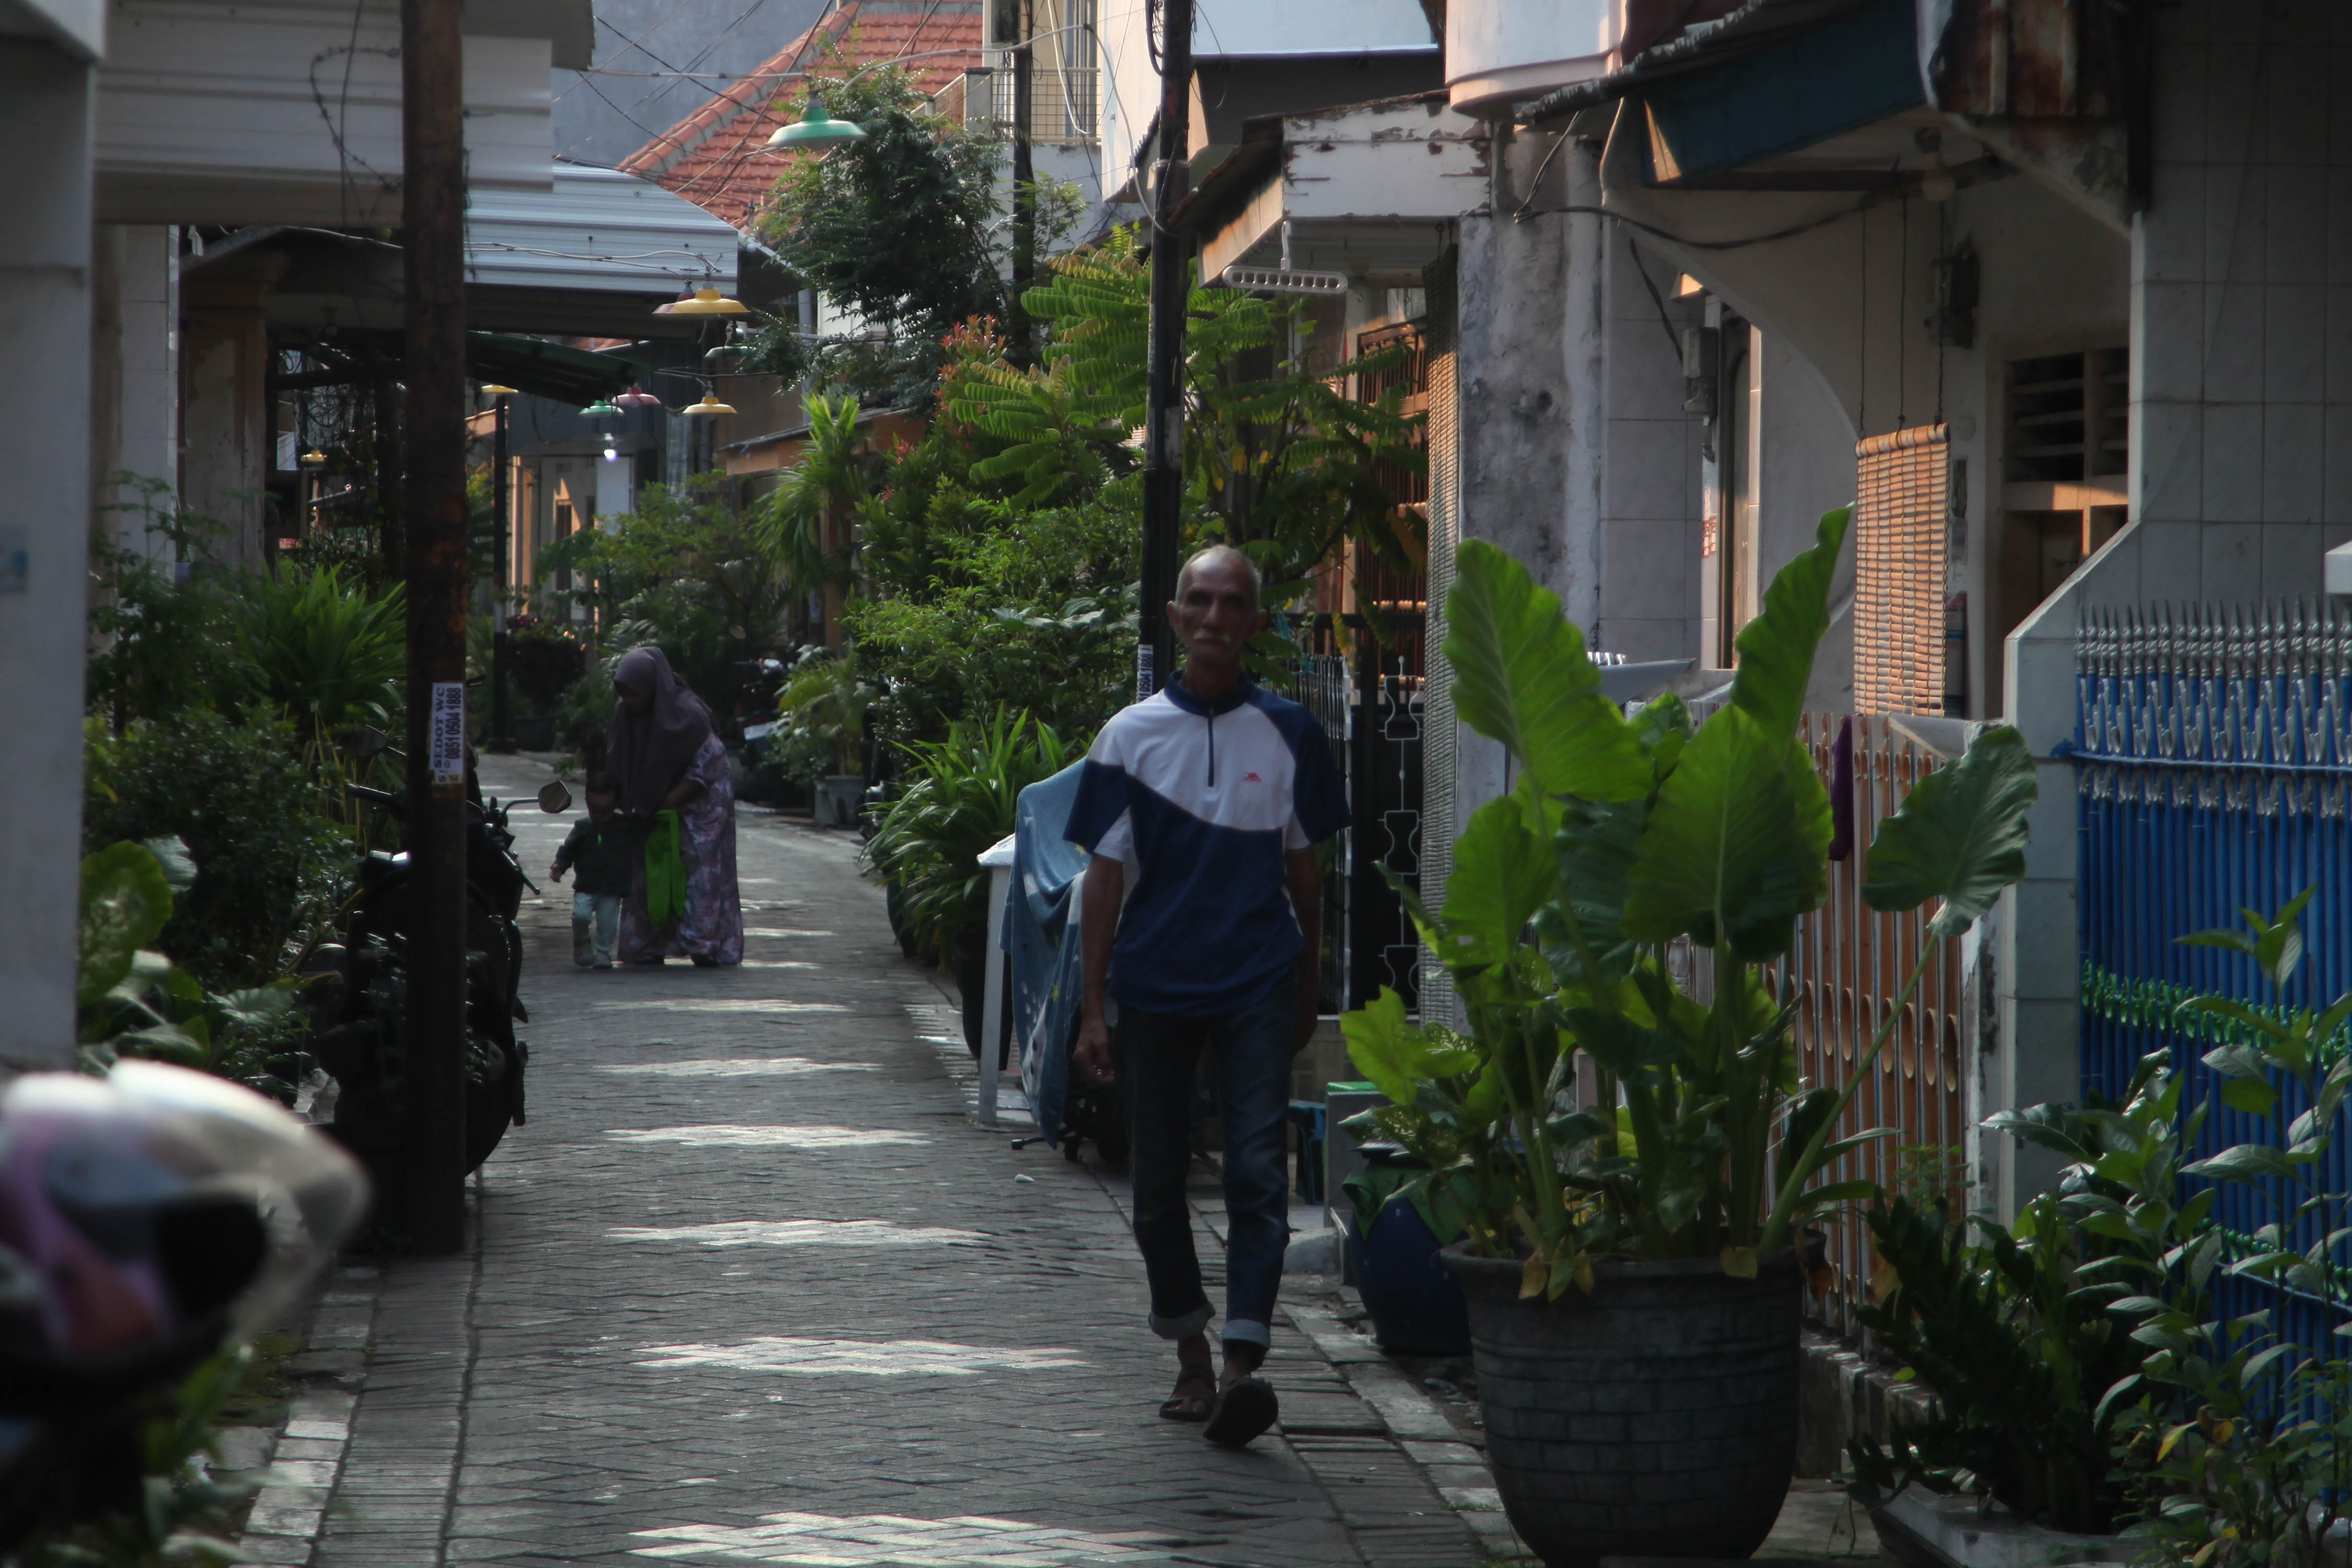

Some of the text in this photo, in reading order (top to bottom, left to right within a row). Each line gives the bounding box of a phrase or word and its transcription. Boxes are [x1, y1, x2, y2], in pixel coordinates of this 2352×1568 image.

[1141, 653, 1153, 672] 1888
[1139, 673, 1151, 692] 0504
[445, 687, 462, 710] 1888
[434, 687, 445, 768] SEDOT WC
[444, 712, 461, 735] 0504
[444, 736, 460, 759] 0851
